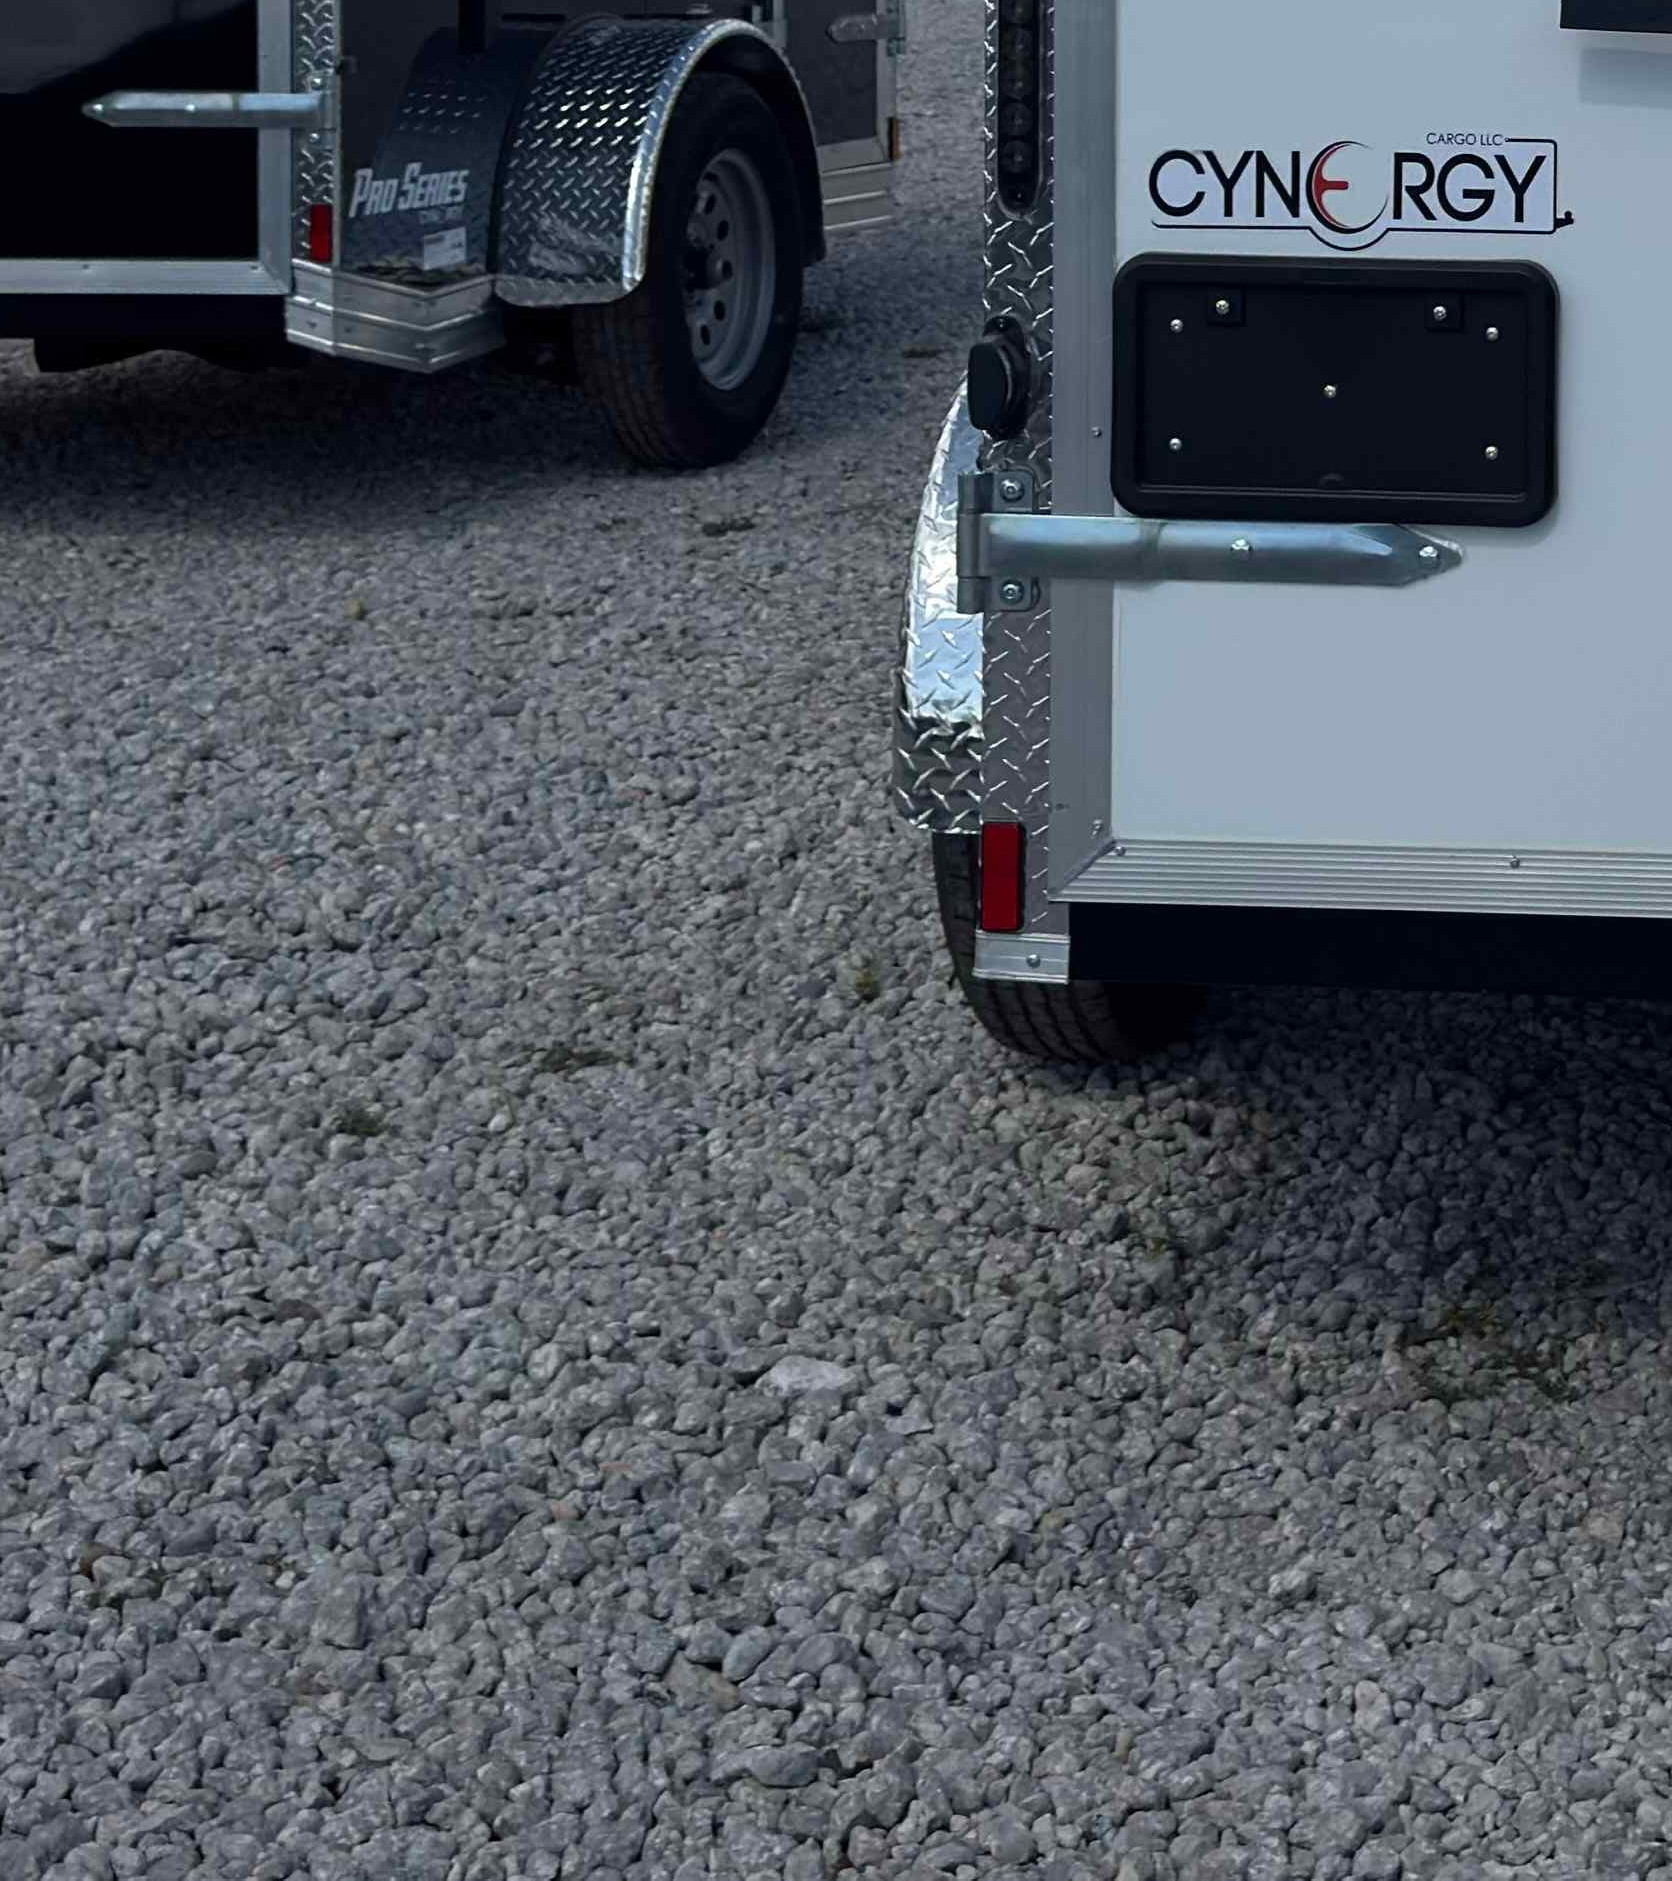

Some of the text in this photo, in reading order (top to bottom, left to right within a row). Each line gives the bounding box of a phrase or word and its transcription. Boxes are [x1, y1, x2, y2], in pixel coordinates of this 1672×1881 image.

[1426, 132, 1504, 146] CARGO LLC
[348, 162, 470, 217] PRO SERIES
[1148, 141, 1547, 234] CYNERGY
